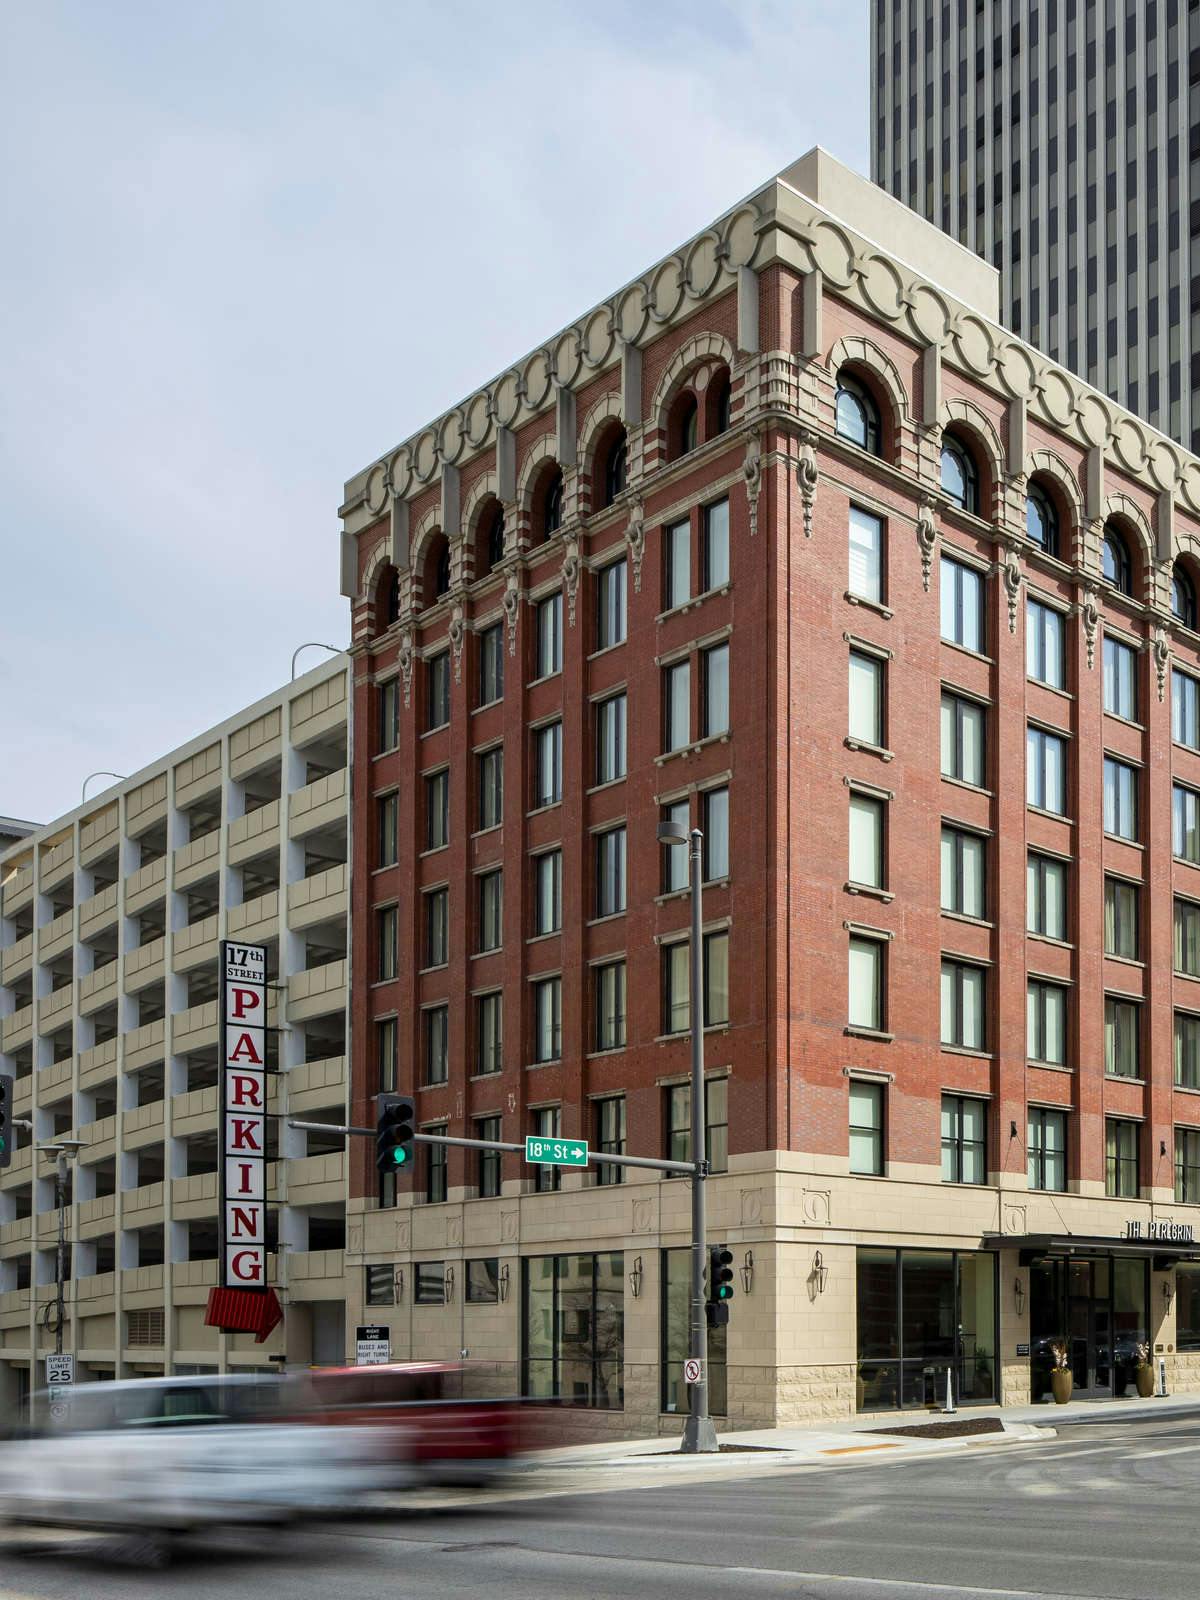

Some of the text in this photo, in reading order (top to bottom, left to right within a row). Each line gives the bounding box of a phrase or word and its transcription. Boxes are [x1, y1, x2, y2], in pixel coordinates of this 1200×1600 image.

[228, 948, 263, 967] 17th
[228, 968, 264, 979] STREET
[228, 988, 263, 1281] PARKING
[530, 1142, 568, 1159] 18th St
[50, 1370, 71, 1381] 25
